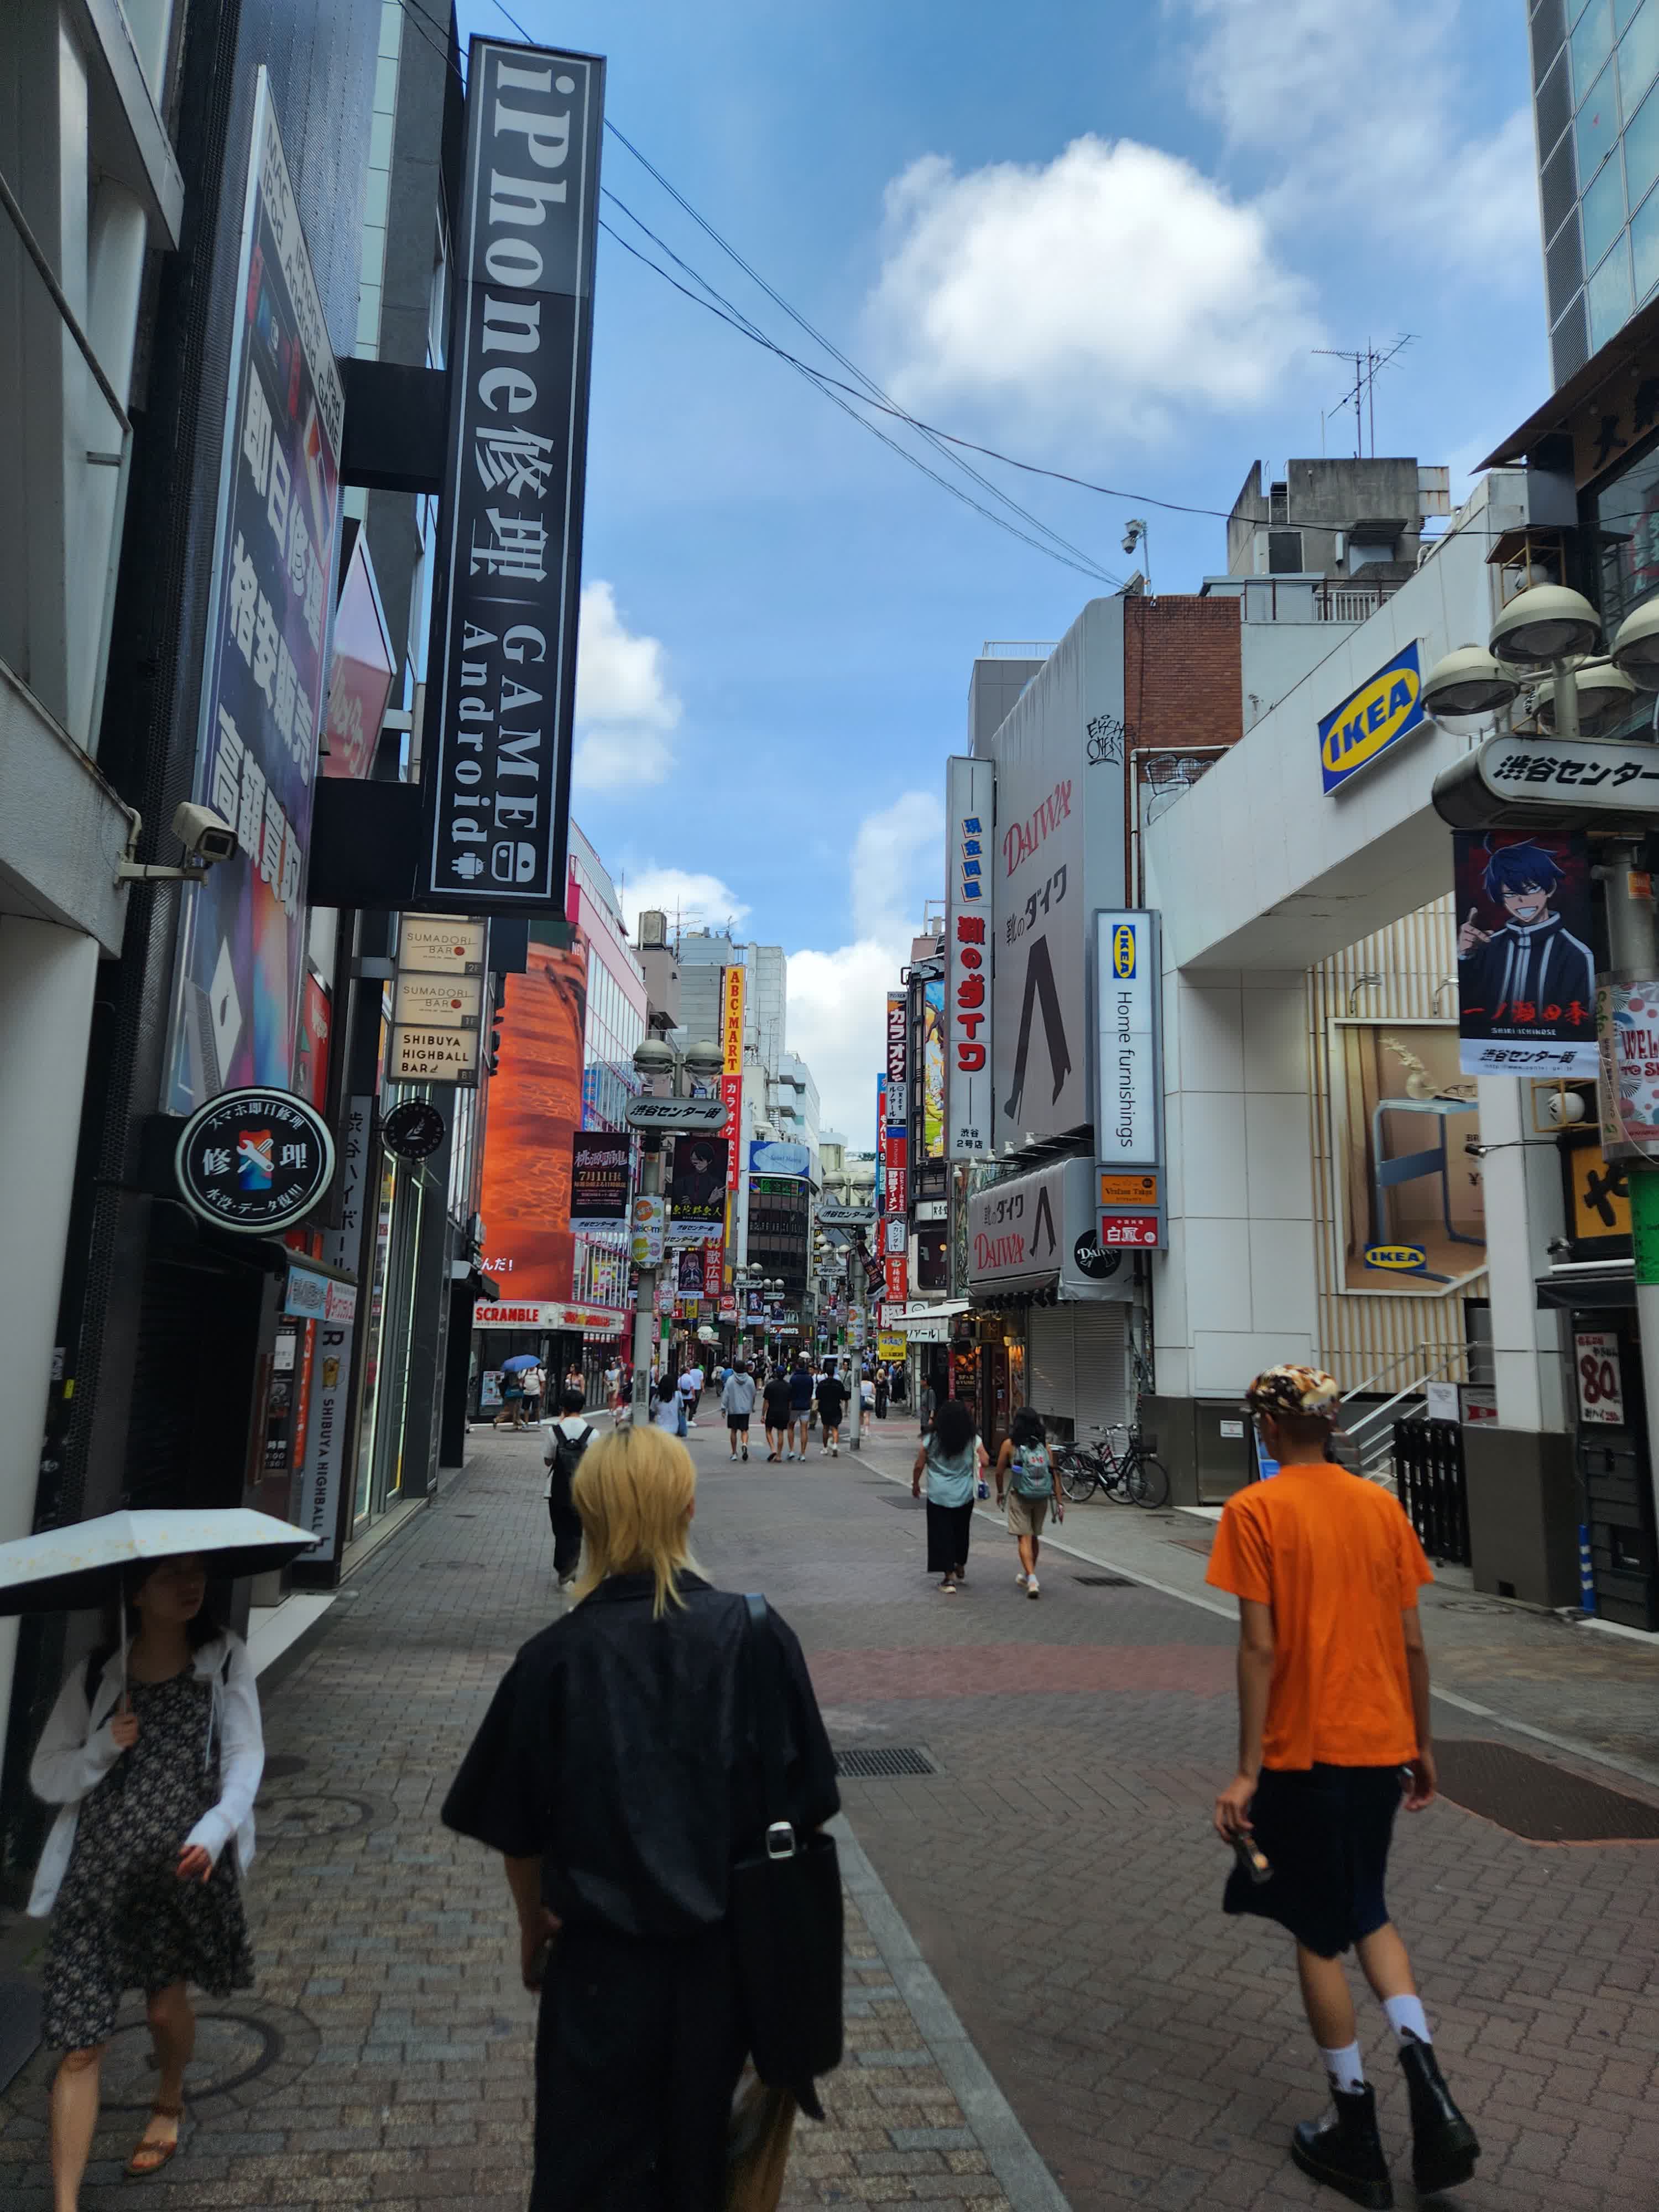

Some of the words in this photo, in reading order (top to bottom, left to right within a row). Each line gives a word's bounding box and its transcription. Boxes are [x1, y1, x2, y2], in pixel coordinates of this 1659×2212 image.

[451, 620, 498, 844] Android
[495, 624, 546, 829] GAME
[1329, 677, 1413, 763] IKEA
[1003, 779, 1072, 878] DAIWA
[962, 817, 983, 902] 現金問屋
[1005, 864, 1067, 947] 靴のダイワ
[407, 933, 472, 945] SUMADORI
[429, 946, 452, 954] BAR
[1120, 930, 1129, 975] IKEA
[403, 986, 468, 998] SUMADORI
[425, 999, 448, 1008] BAR
[957, 916, 986, 1072] 靴のダイワ
[1118, 992, 1132, 1043] Home
[403, 1034, 461, 1046] SHIBUYA
[402, 1049, 469, 1061] HIGHBALL
[402, 1063, 427, 1073] BAR
[1479, 1048, 1578, 1063] 渋谷センター街
[630, 1104, 721, 1120] 渋谷センター街
[1116, 1048, 1135, 1147] furnishings
[208, 1102, 305, 1131] スマホ即日修理
[957, 1140, 983, 1150] 2号店
[960, 1129, 979, 1138] 渋谷
[974, 1233, 1025, 1270] DAIWA
[1370, 1251, 1421, 1262] IKEA
[706, 1250, 721, 1293] 歌広場
[476, 1307, 539, 1322] SCRAMBLE
[906, 1329, 936, 1339] ノアール
[319, 1398, 334, 1457] SHIBUYA
[312, 1462, 328, 1531] HIGHBALL
